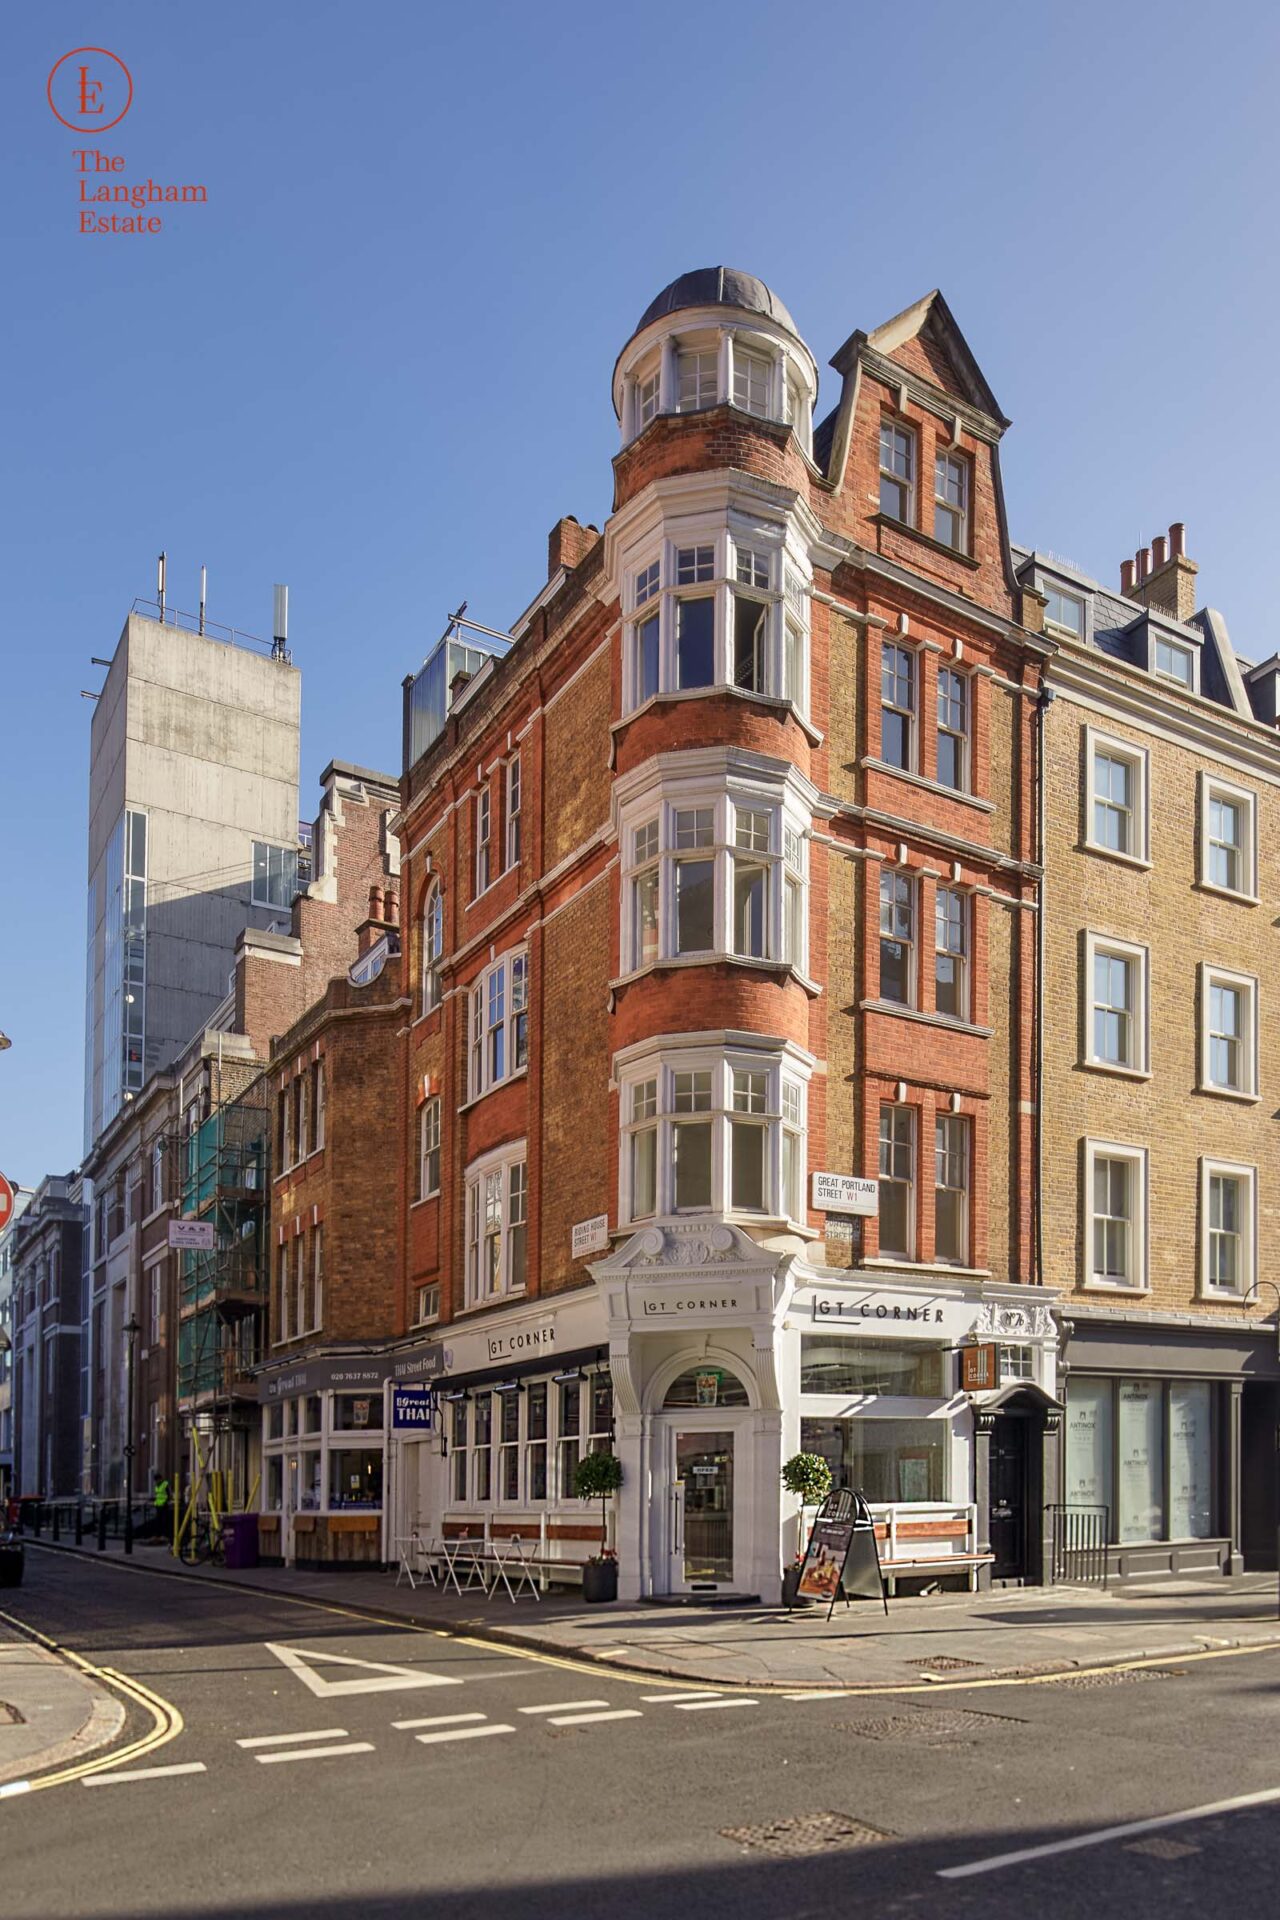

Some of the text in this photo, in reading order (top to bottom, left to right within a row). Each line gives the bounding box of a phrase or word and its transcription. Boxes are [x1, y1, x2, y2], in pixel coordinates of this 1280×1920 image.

[818, 1176, 876, 1193] GREAT PORTLAND
[817, 1187, 858, 1201] STREET W1
[574, 1217, 606, 1237] RIDING HOUSE
[574, 1233, 590, 1248] STREET
[648, 1299, 738, 1311] GT CORNER
[819, 1301, 944, 1323] GT CORNER
[490, 1328, 555, 1354] GT CORNER
[406, 1360, 422, 1374] Street
[422, 1355, 437, 1370] Food
[402, 1396, 430, 1407] Great
[396, 1407, 430, 1421] THAI
